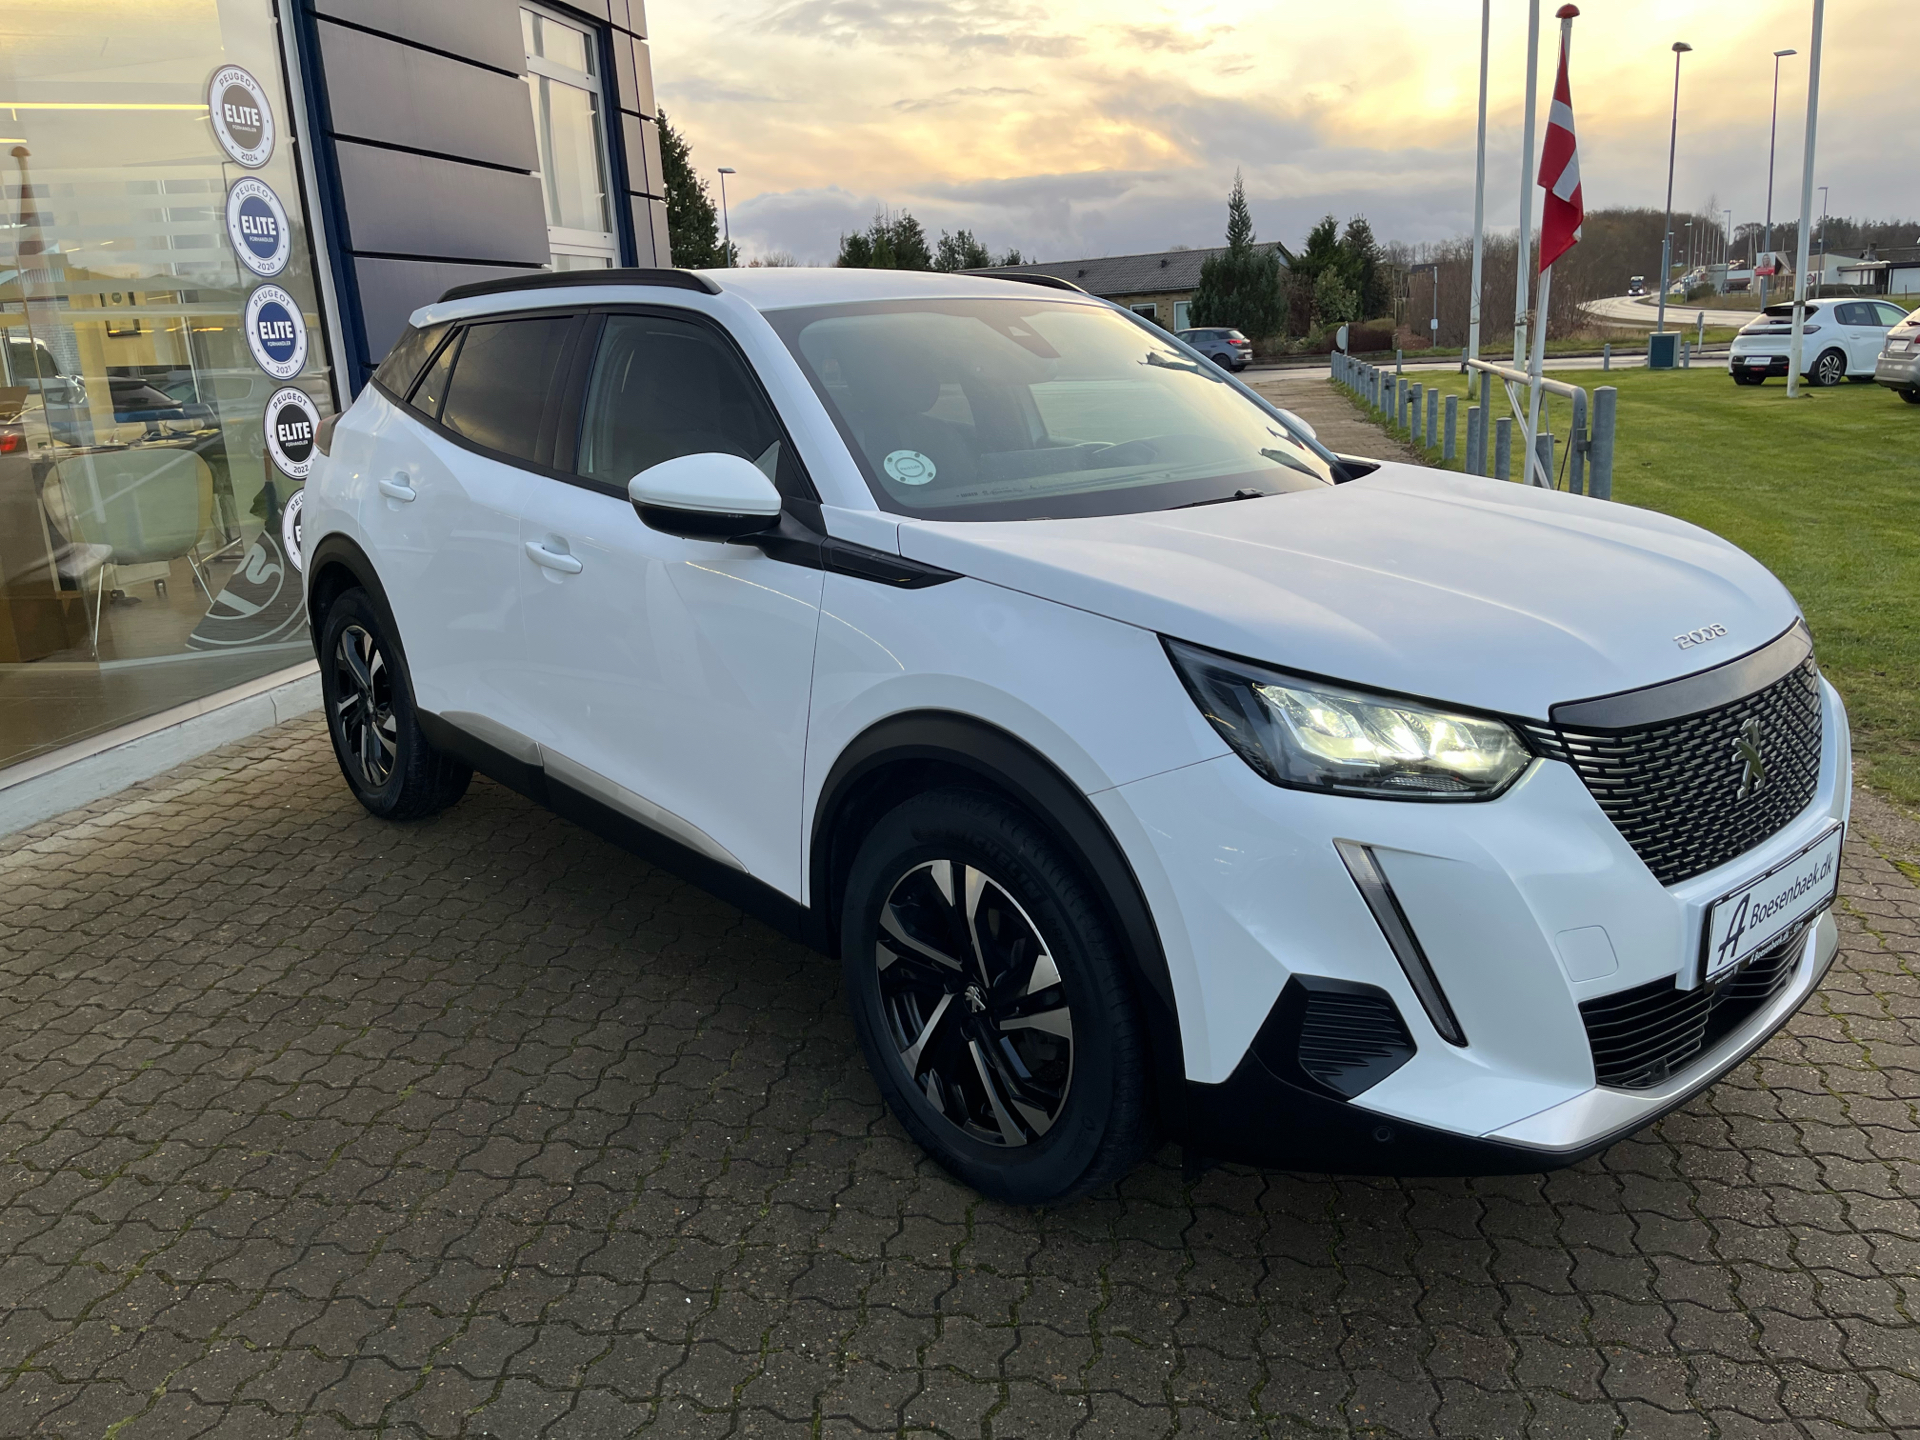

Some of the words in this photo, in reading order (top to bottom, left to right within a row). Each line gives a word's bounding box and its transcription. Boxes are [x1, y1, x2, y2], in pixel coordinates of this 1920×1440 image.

[219, 72, 257, 91] PEUGEOT
[223, 103, 260, 126] ELITE
[241, 151, 258, 161] 2024
[235, 184, 273, 202] PEUGEOT
[241, 215, 277, 235] ELITE
[257, 261, 275, 270] 2020
[253, 289, 290, 307] PEUGEOT
[259, 321, 294, 339] ELITE
[276, 365, 292, 374] 2021
[272, 392, 308, 410] PEUGEOT
[277, 421, 312, 441] ELITE
[293, 465, 309, 473] 2022
[1673, 623, 1728, 650] 2008
[1750, 852, 1834, 930] Boesenbaek.dk
